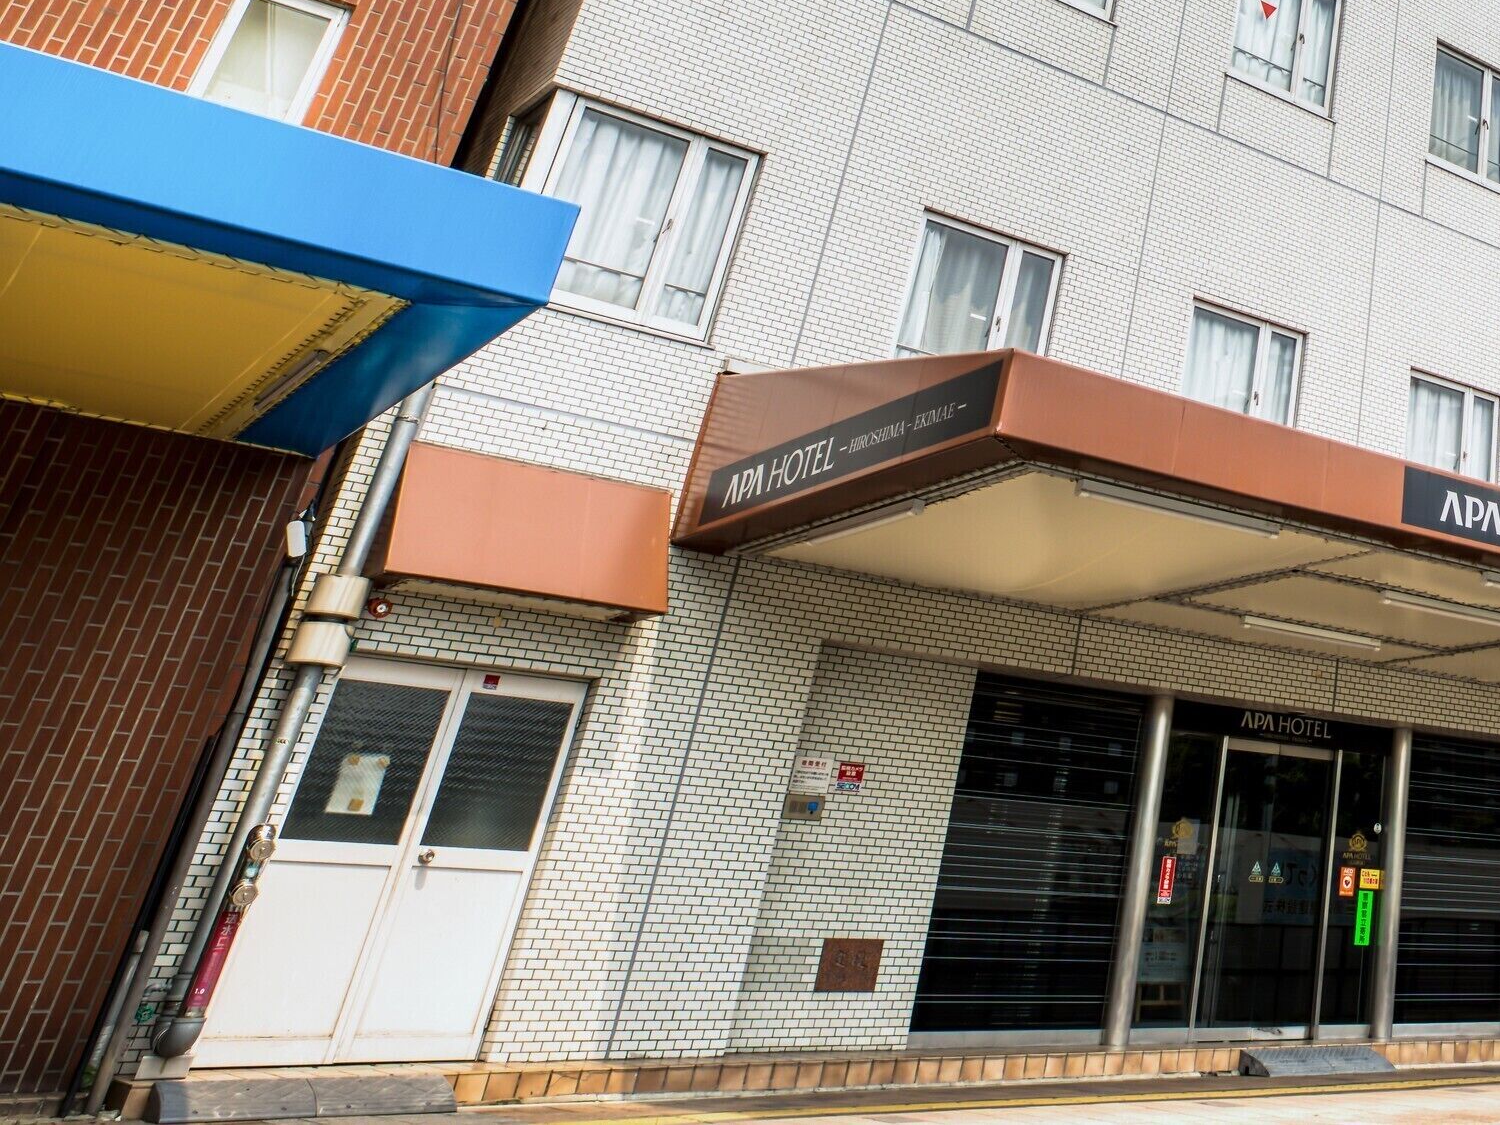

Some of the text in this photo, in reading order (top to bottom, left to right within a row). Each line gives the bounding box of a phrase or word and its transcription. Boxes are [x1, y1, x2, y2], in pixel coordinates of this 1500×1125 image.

[721, 463, 764, 509] APA
[767, 437, 834, 492] HOTEL
[1241, 711, 1274, 731] APA
[1278, 716, 1331, 739] HOTEL
[836, 782, 860, 791] SECOM
[213, 913, 238, 951] 送水口
